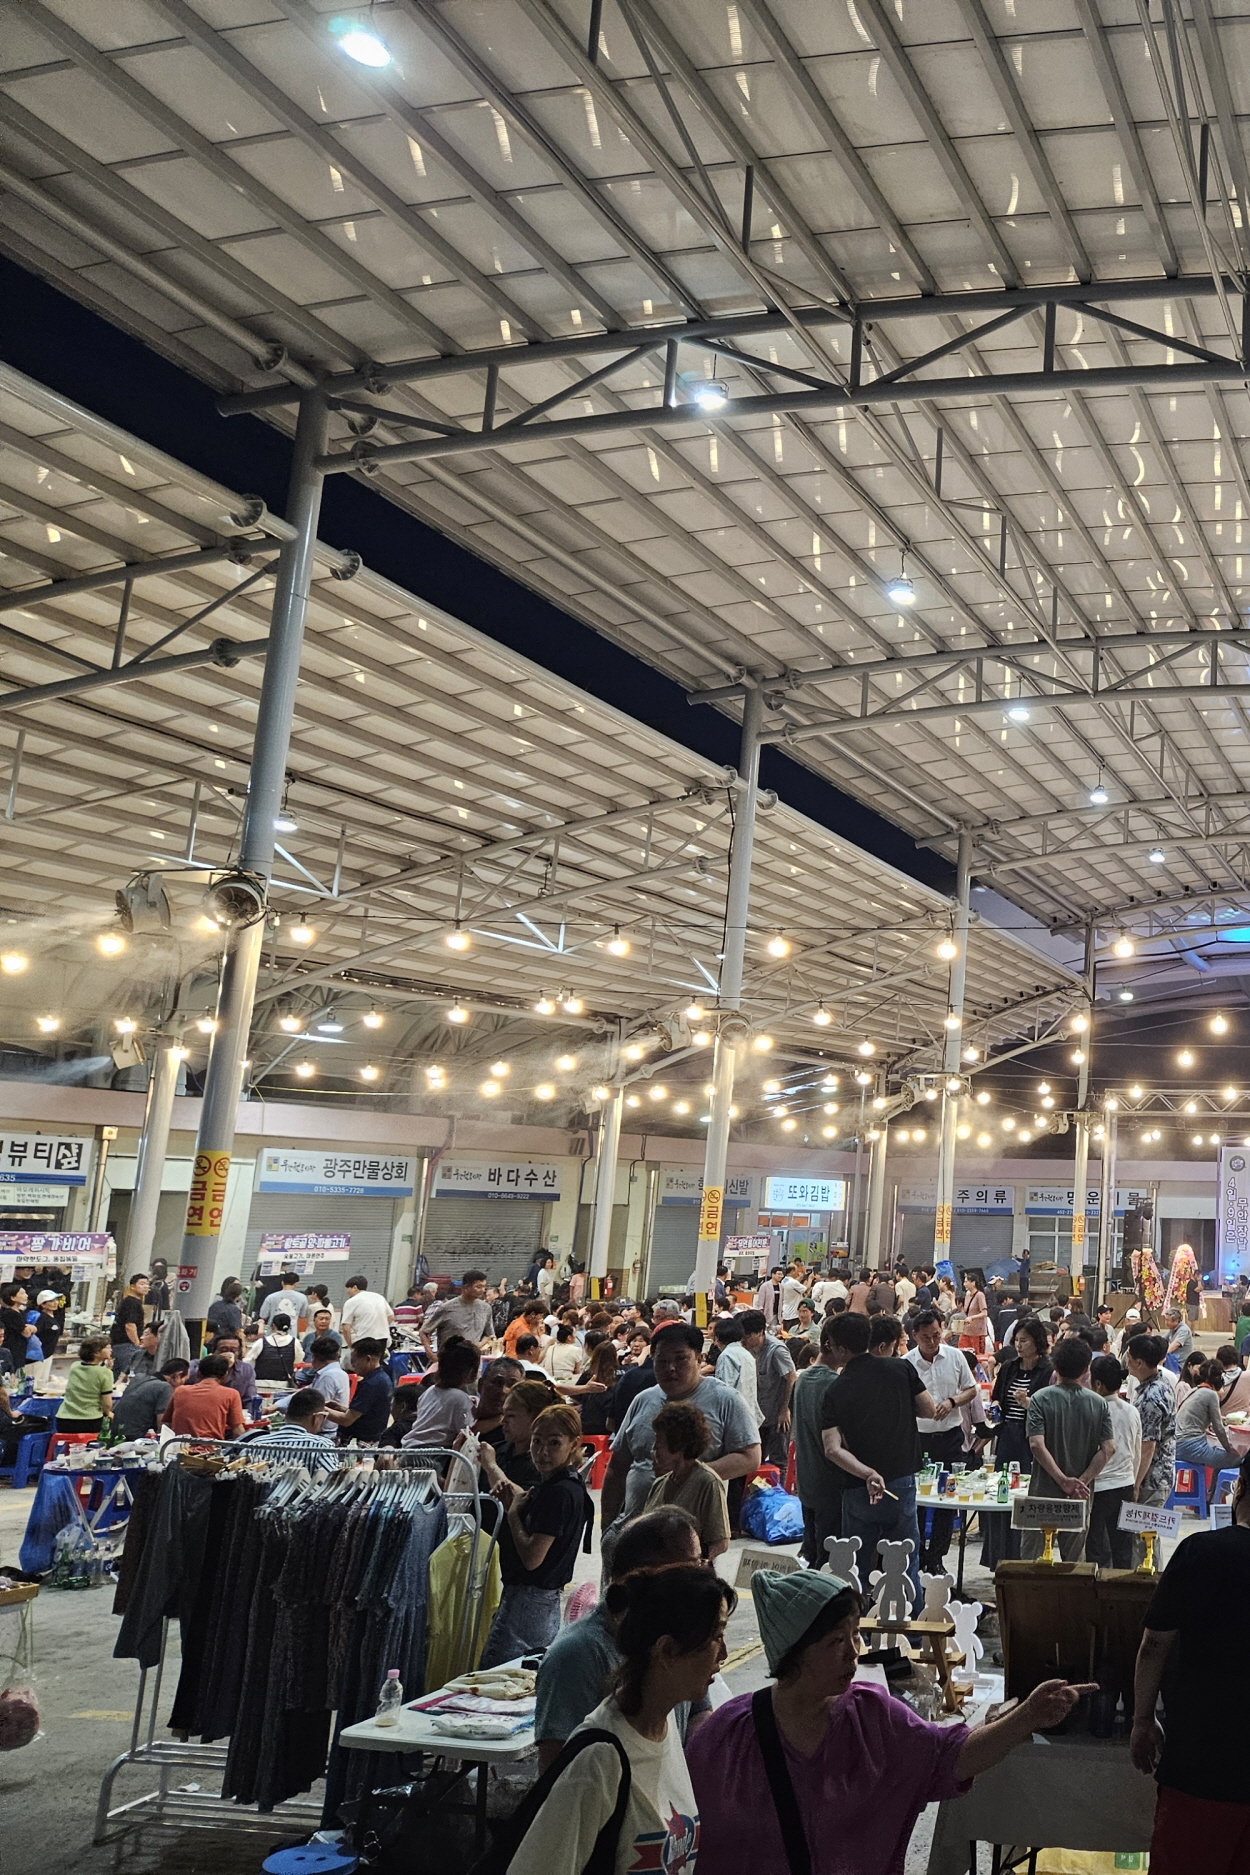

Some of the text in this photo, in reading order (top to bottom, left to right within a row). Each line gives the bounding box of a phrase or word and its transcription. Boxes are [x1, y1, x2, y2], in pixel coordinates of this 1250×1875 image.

[323, 1158, 408, 1182] 광주만물상회
[487, 1167, 557, 1188] 바다수산
[187, 1180, 208, 1227] 금연
[788, 1184, 831, 1202] 또와김밥
[705, 1205, 719, 1235] 금연
